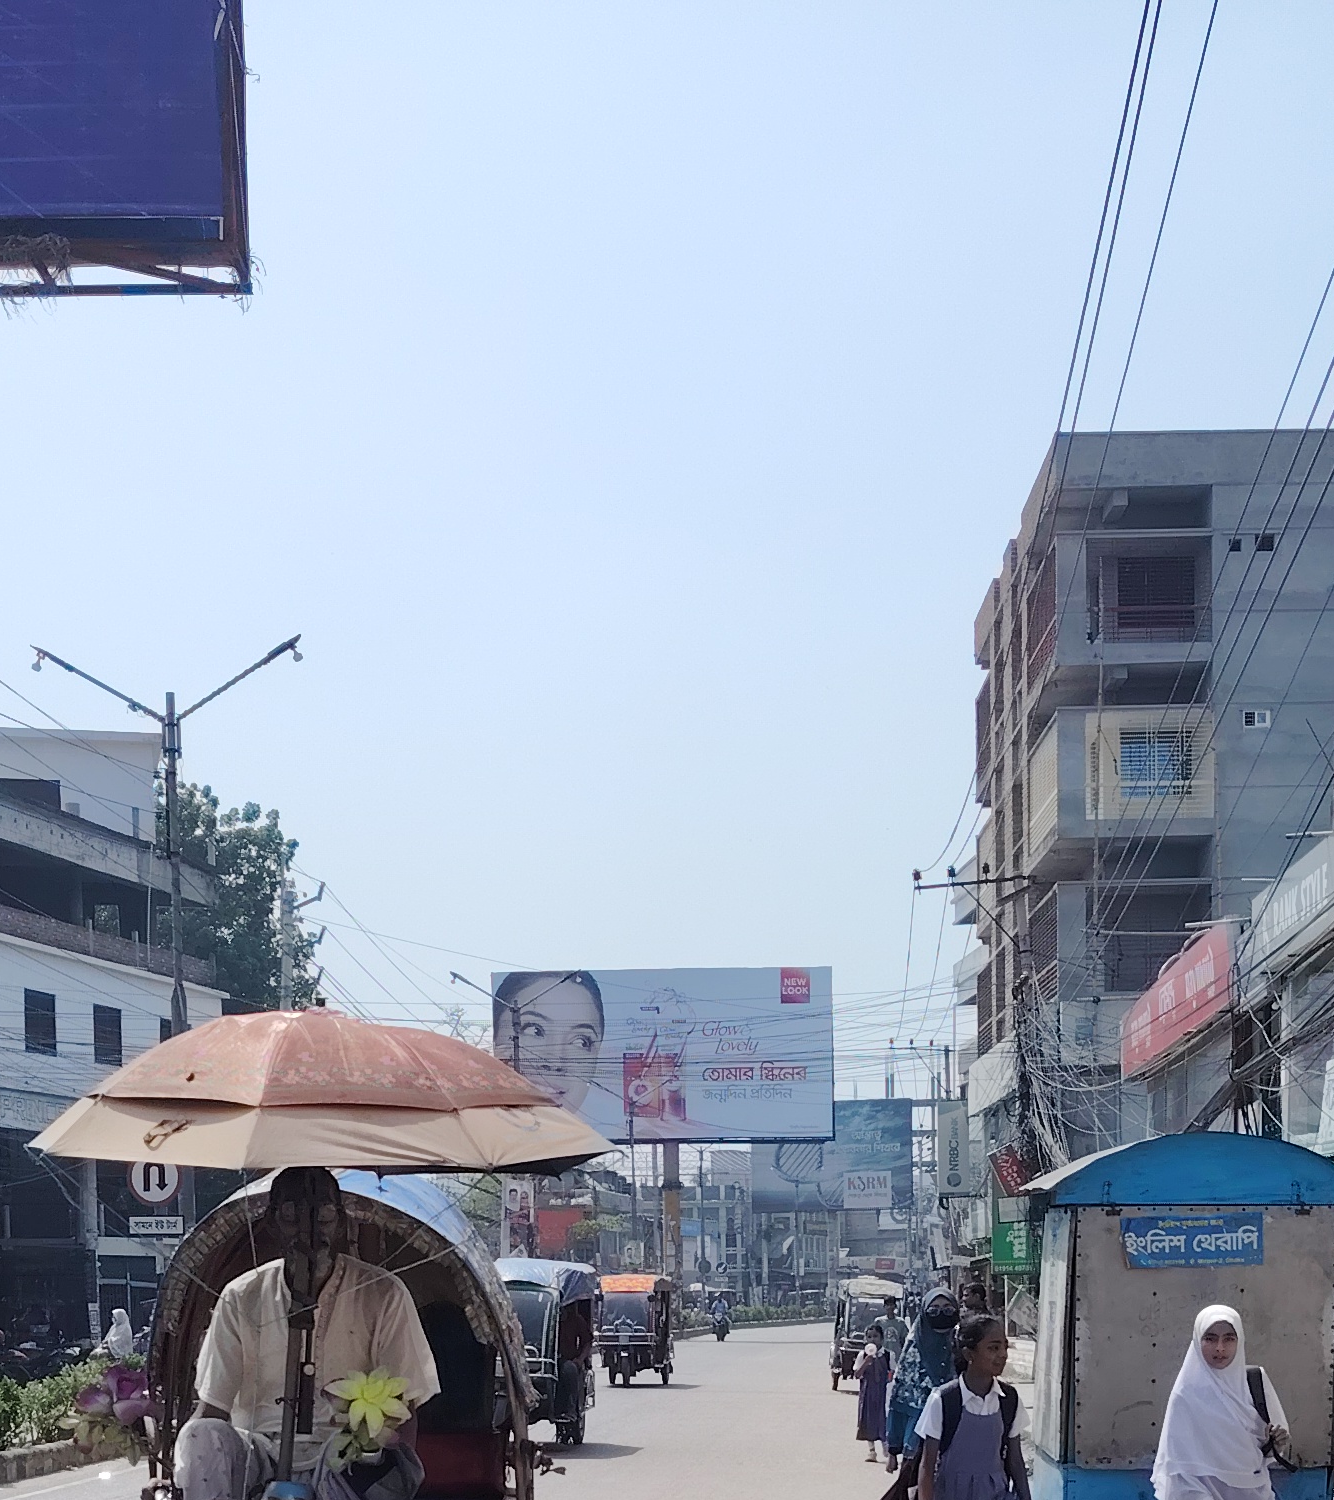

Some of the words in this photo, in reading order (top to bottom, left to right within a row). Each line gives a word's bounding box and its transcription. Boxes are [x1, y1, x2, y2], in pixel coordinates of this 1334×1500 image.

[782, 986, 809, 995] LOOK
[784, 977, 807, 986] NEW
[702, 1066, 757, 1081] তোমার
[760, 1061, 808, 1081] স্কিনের
[702, 1083, 747, 1103] জন্মদিন
[750, 1083, 793, 1100] প্রতিদিন
[948, 1139, 960, 1172] NRBC
[847, 1175, 887, 1192] KSRM
[1124, 1228, 1187, 1256] ইংলিশ
[1192, 1225, 1259, 1252] থেরাপি
